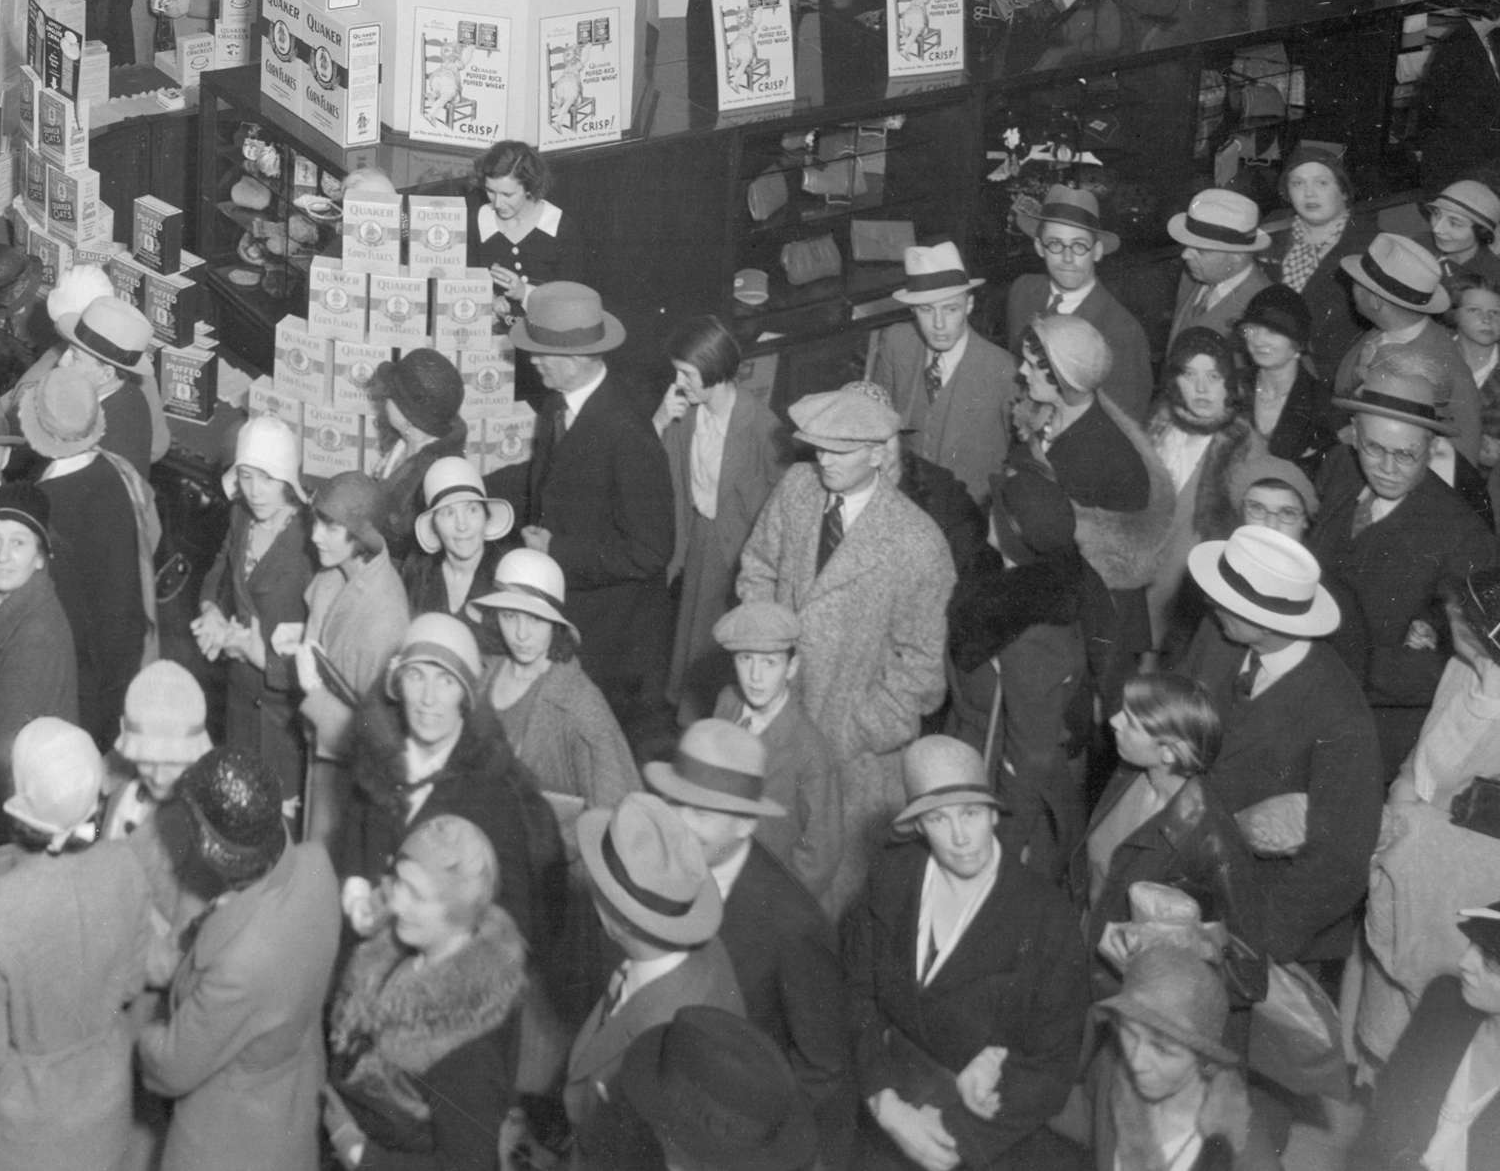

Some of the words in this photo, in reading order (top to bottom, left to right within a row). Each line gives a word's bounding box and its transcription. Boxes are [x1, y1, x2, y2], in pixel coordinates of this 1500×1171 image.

[307, 13, 341, 47] QUAKER
[929, 46, 959, 62] CRISP!
[266, 59, 278, 78] CORN
[278, 66, 297, 90] FLAKES
[758, 76, 788, 92] CRISP!
[306, 85, 320, 104] CORN
[320, 94, 339, 119] FLAKES
[460, 123, 499, 139] CRISP!
[582, 115, 615, 132] CRISP!
[53, 210, 73, 220] OATS
[349, 204, 395, 218] QUAKER
[417, 210, 461, 222] QUAKER
[148, 285, 177, 304] PUFFED
[377, 281, 421, 292] QUAKER
[444, 284, 487, 295] QUAKER
[281, 331, 320, 349] QUAKER
[341, 345, 386, 358] QUAKER
[165, 362, 202, 378] PUFFED
[172, 373, 195, 385] RICE
[310, 408, 353, 424] QUAKER
